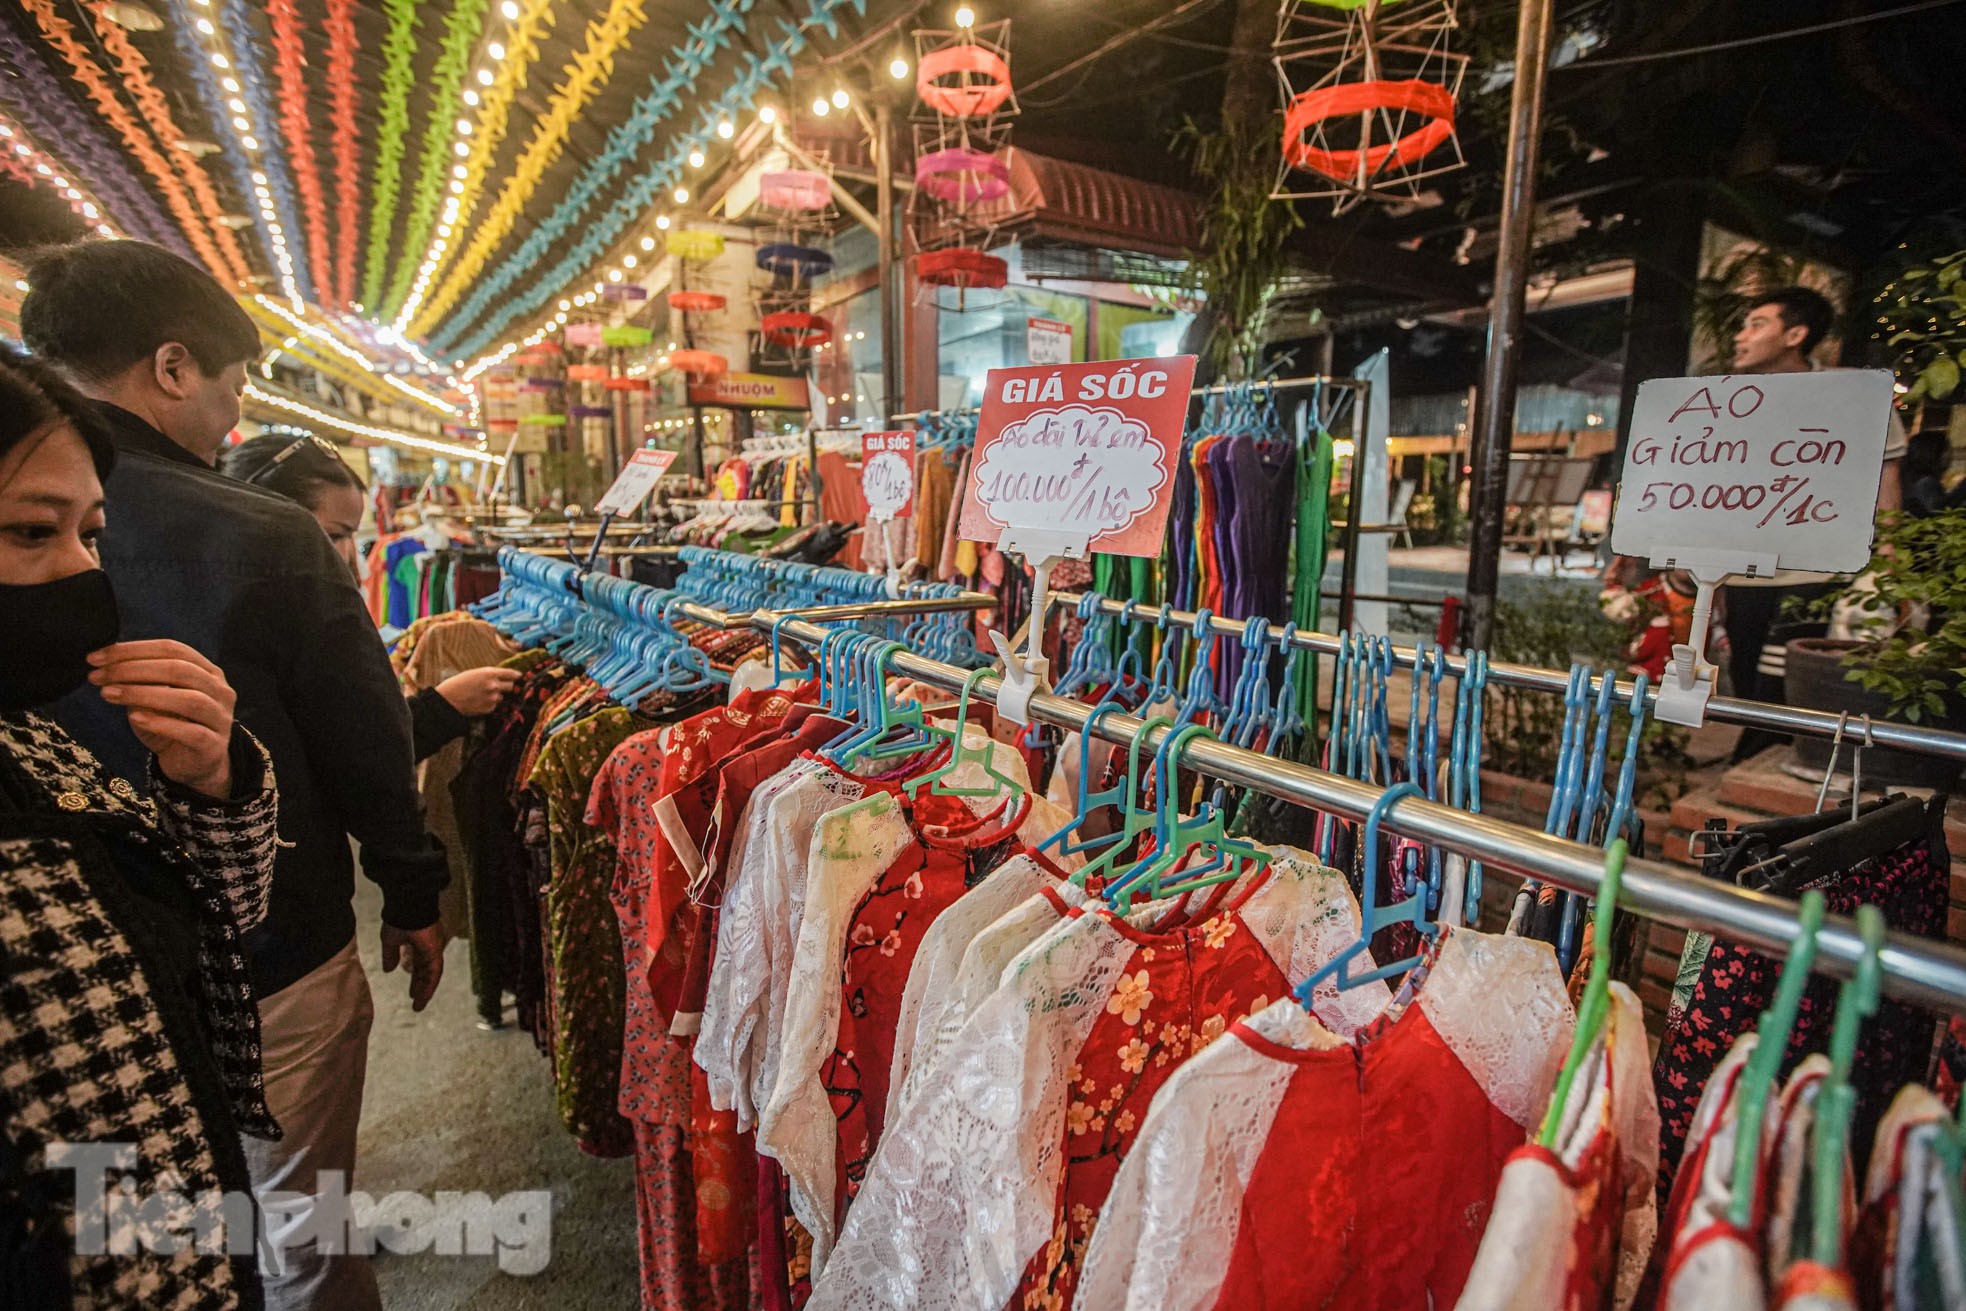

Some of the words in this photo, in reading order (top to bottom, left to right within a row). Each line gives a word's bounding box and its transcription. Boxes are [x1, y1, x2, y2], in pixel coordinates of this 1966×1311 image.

[1001, 371, 1064, 404] GIÁ
[1078, 362, 1168, 401] SỐC
[866, 434, 887, 451] GIÁ
[887, 433, 911, 450] SỐC
[1631, 426, 1749, 466] Giảm
